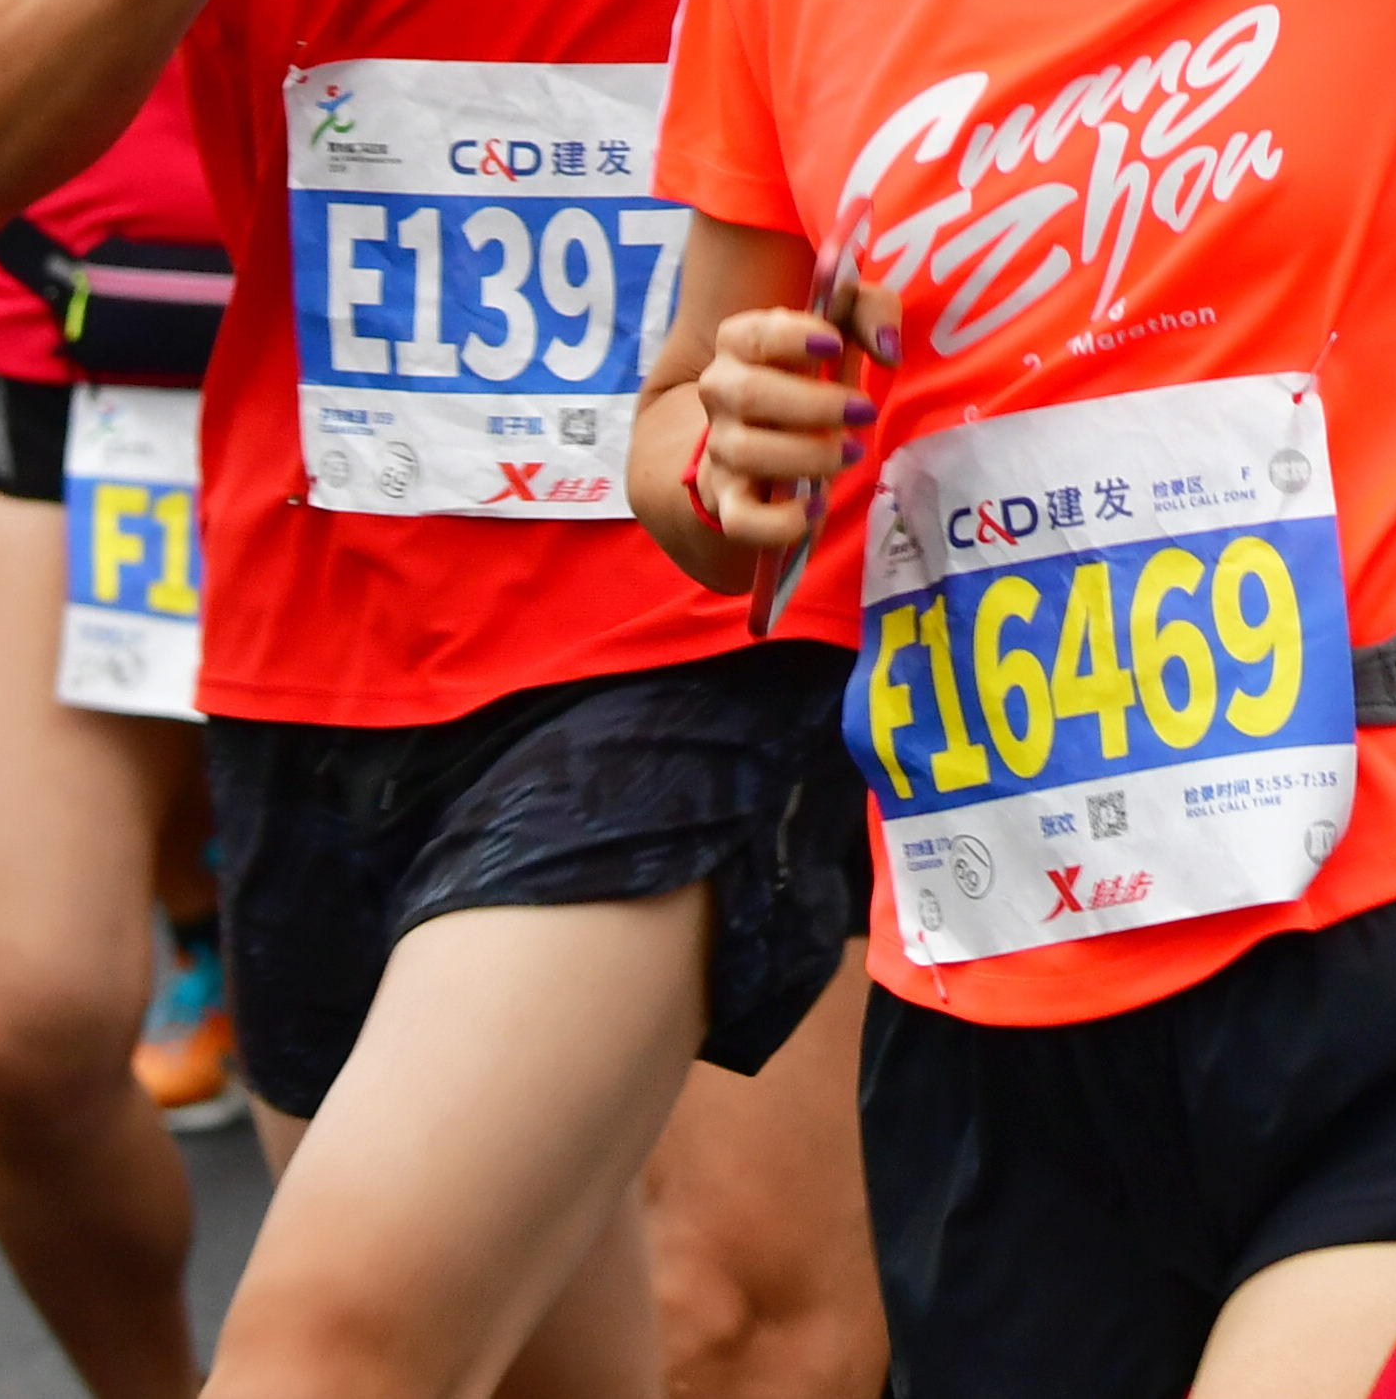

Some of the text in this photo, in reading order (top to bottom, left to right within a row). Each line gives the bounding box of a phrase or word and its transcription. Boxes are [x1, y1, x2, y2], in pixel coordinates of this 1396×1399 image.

[449, 138, 543, 183] C&D
[550, 140, 632, 177] 建发
[1066, 305, 1218, 357] Marathon
[947, 476, 1134, 551] C&D 建发
[1153, 487, 1257, 513] ROLL CALL ZONE
[92, 482, 200, 615] F1
[868, 535, 1304, 800] F16469
[1183, 779, 1251, 806] 检录时间
[1185, 795, 1283, 819] ROLL CALL TIME
